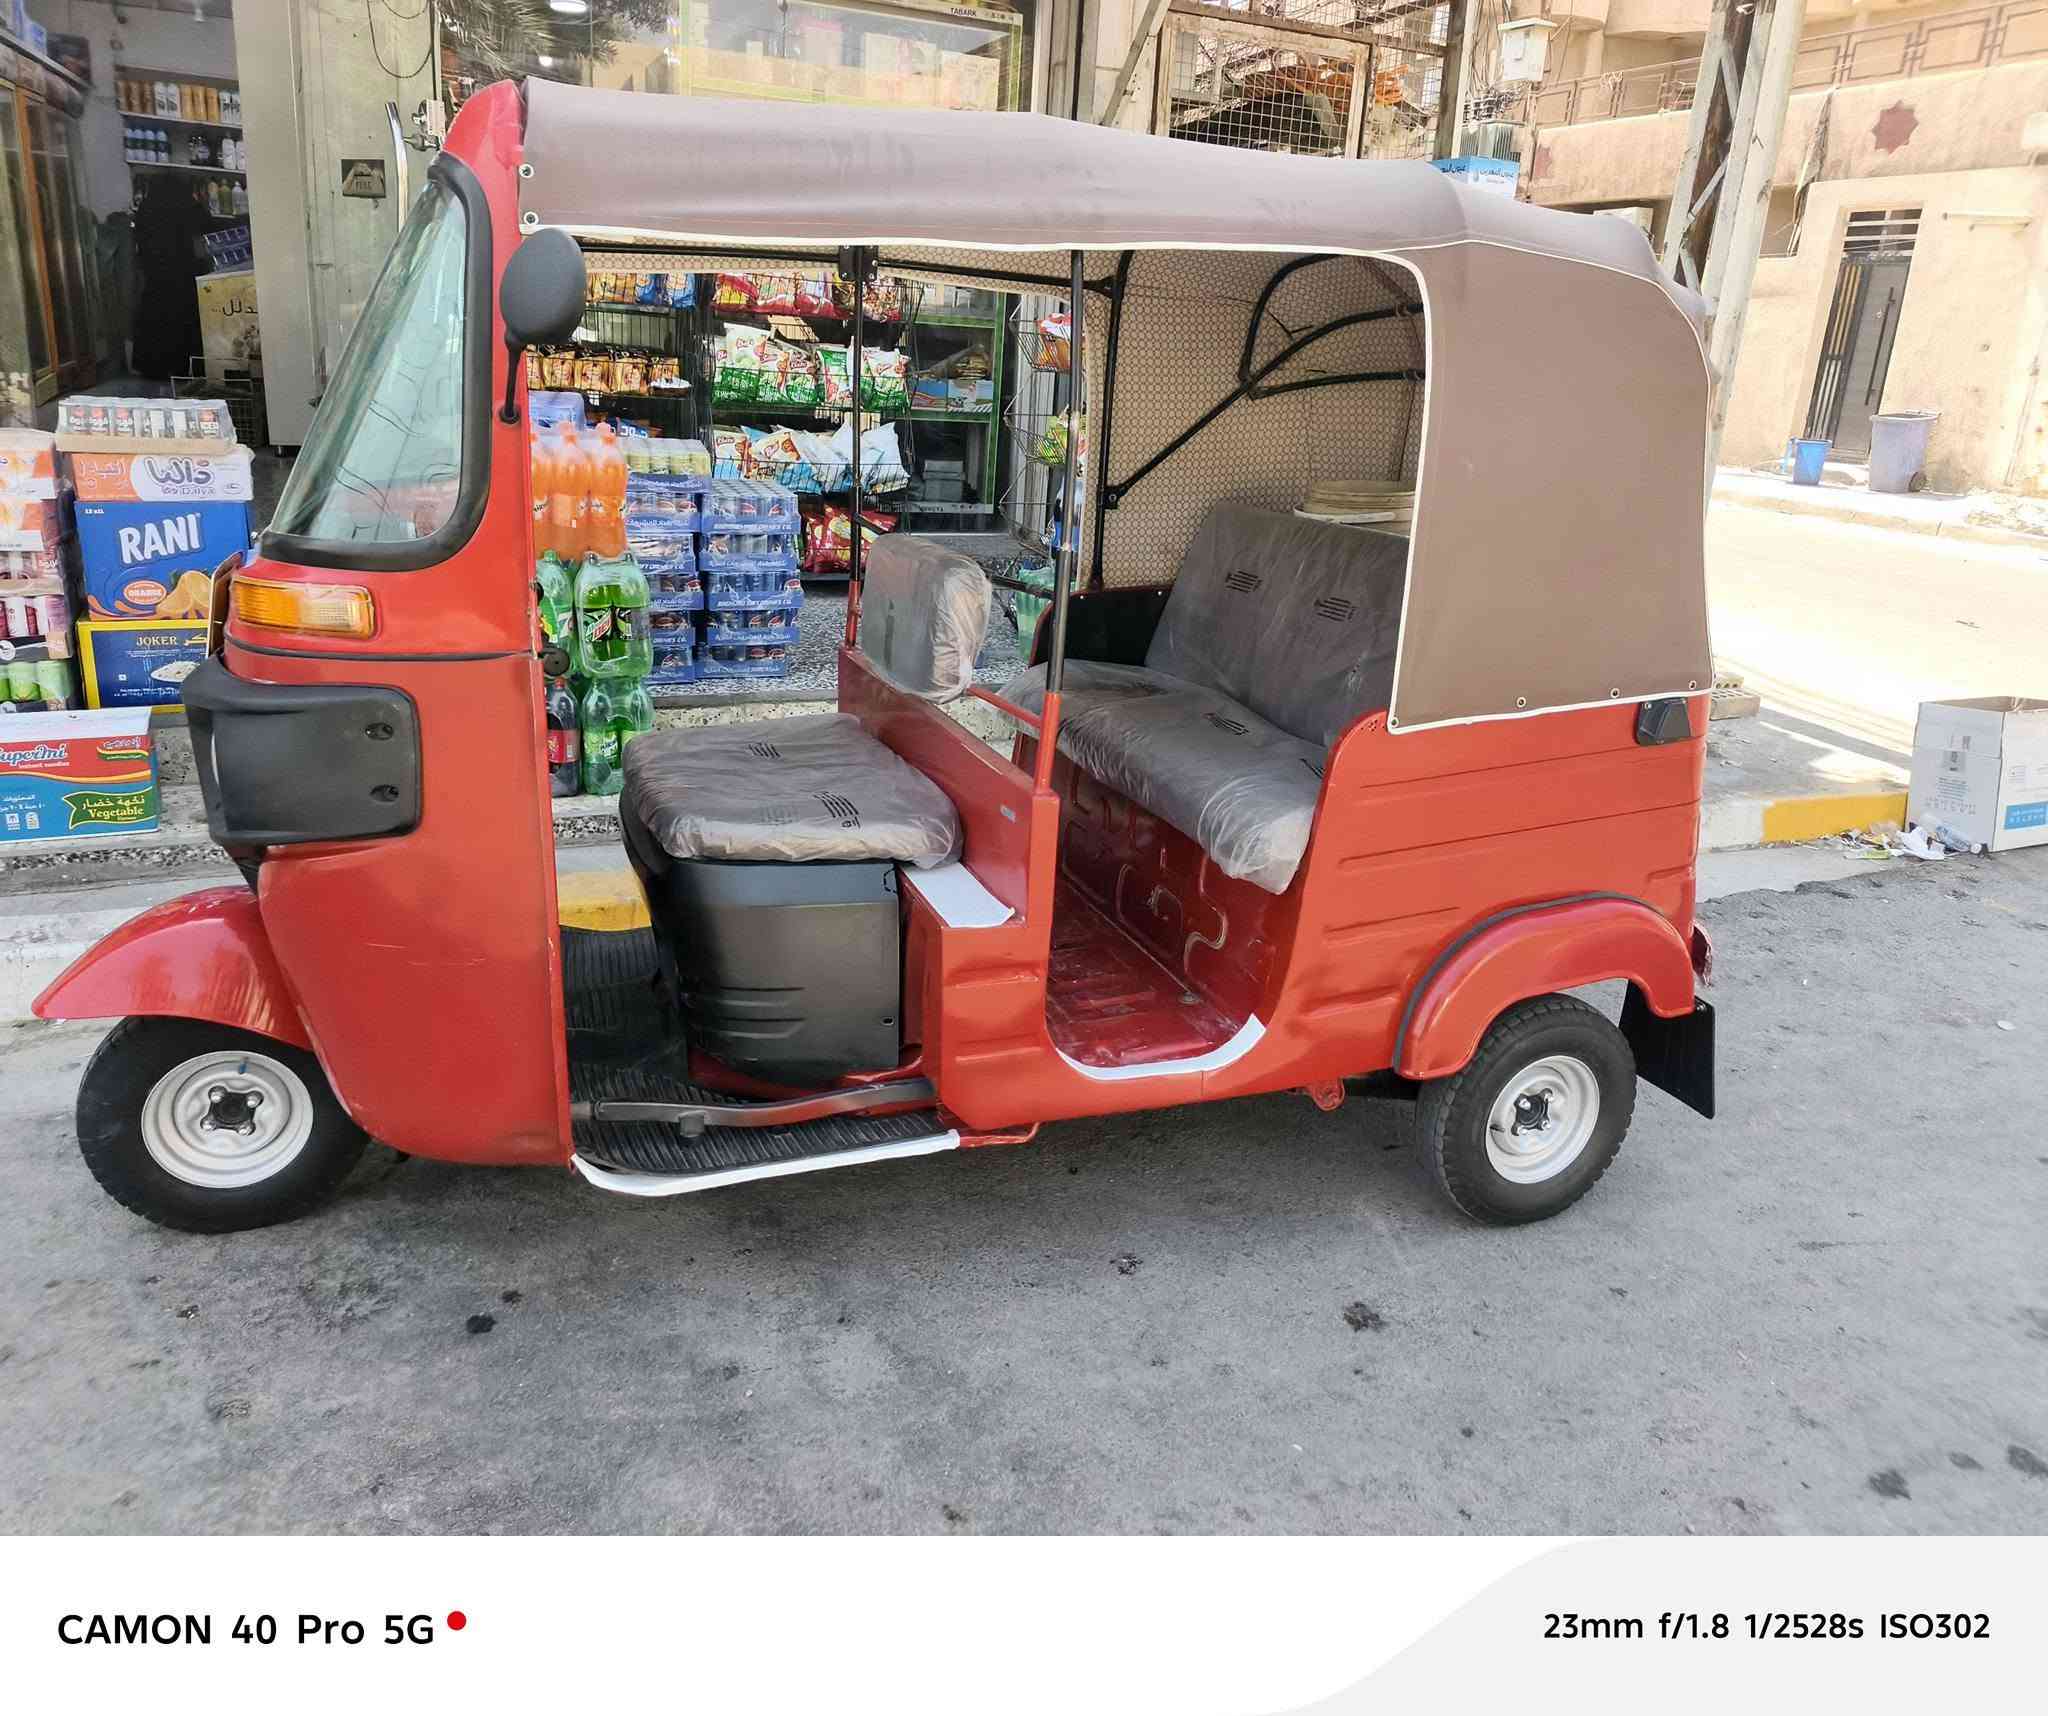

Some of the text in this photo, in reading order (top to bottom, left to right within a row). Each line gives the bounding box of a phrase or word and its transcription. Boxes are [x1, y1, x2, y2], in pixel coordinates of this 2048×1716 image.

[950, 7, 977, 17] TABARK
[119, 513, 201, 564] RANI
[136, 635, 177, 646] JOKER
[88, 805, 145, 819] Vegetable
